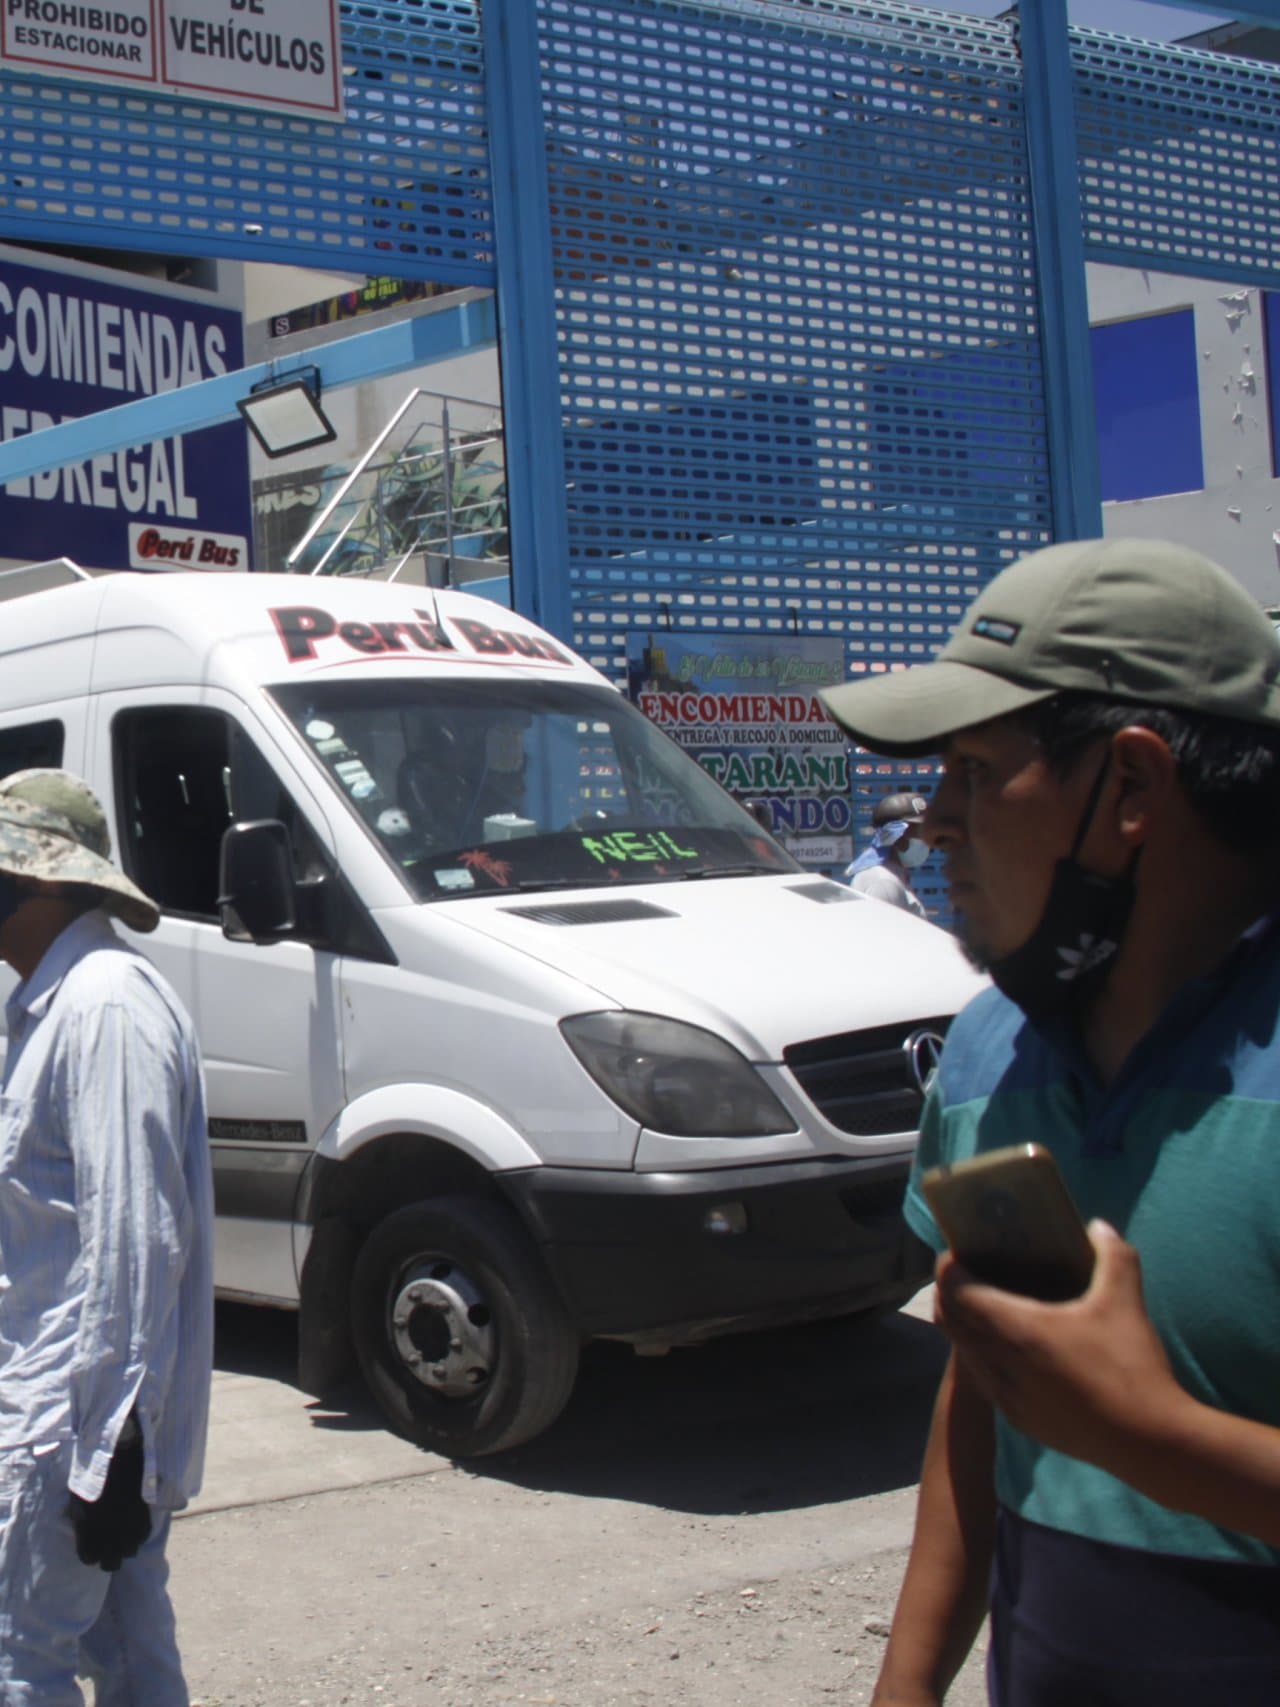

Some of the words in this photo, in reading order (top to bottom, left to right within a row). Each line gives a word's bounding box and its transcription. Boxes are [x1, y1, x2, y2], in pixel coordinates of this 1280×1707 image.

[7, 0, 147, 38] PROHIBIDO
[14, 25, 143, 62] ESTACIONAR
[170, 16, 325, 75] VEHÍCULOS
[138, 529, 194, 562] Perú
[201, 538, 240, 567] Bus
[267, 606, 458, 664] Perú
[447, 616, 575, 666] Bus
[722, 729, 729, 744] Y
[733, 729, 778, 744] RECOJO
[779, 730, 786, 744] A
[789, 729, 845, 745] DOMICILIO
[581, 831, 698, 863] NEIL
